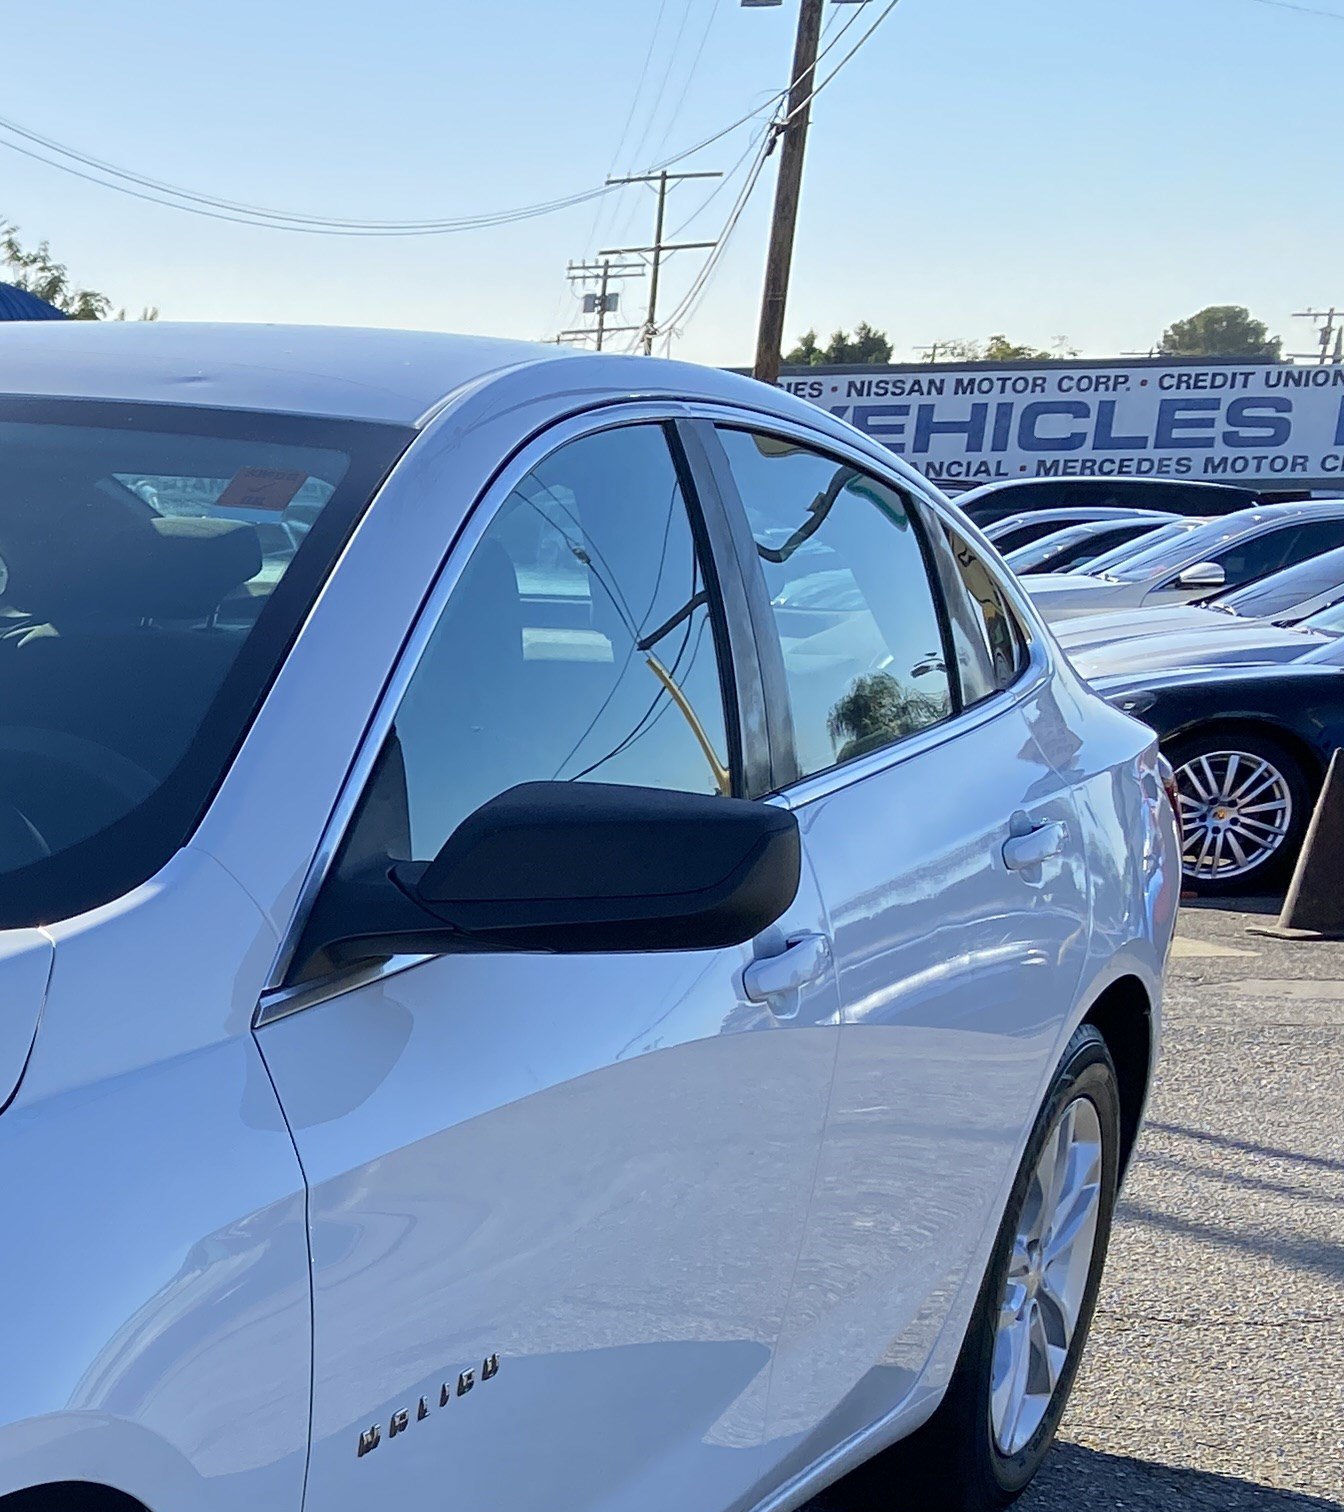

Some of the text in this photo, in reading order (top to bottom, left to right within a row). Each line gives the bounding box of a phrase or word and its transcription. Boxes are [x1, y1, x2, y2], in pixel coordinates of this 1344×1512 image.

[846, 378, 946, 398] NISSAN
[953, 376, 1047, 396] MOTOR
[1057, 374, 1132, 393] CORP.
[1158, 371, 1256, 391] CREDIT
[1035, 456, 1193, 477] MERCEDES
[1202, 455, 1309, 475] MOTOR
